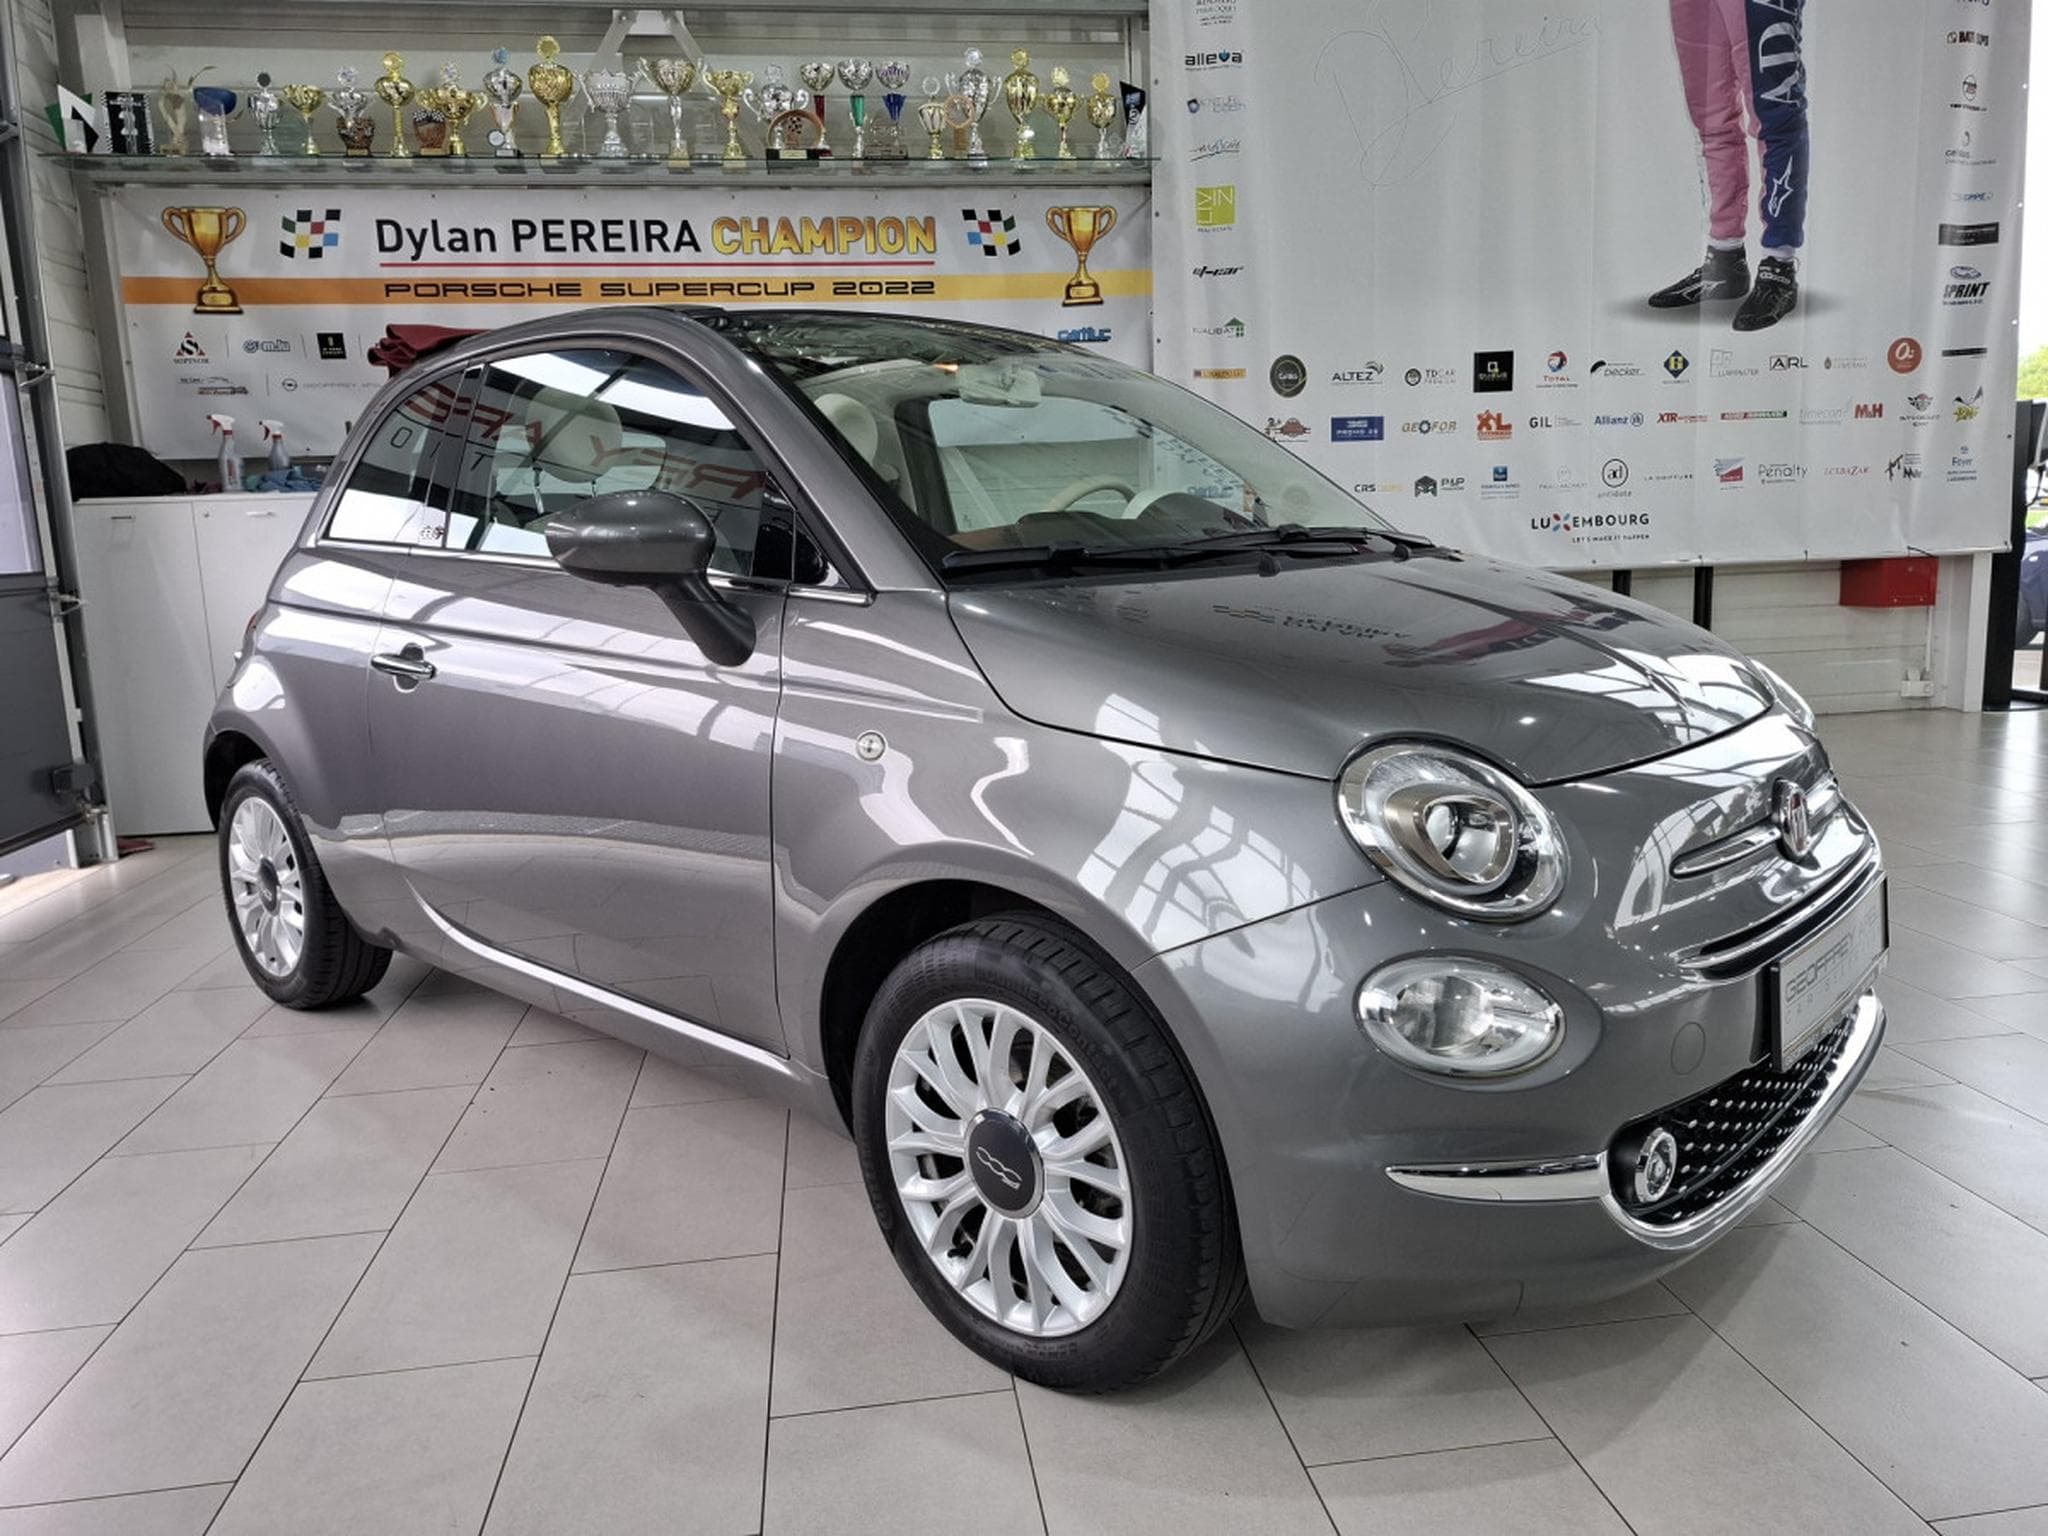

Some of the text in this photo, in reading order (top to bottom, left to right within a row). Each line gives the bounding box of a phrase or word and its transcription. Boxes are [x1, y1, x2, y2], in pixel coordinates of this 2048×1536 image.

[375, 215, 938, 262] Dylan PEREIRA CHAMPION
[384, 280, 935, 298] PORSCHE SUPERCUP 2022
[1770, 356, 1810, 371] ARL
[1332, 371, 1374, 382] ALTEZ
[1529, 416, 1553, 429] GIL
[1594, 415, 1628, 426] Allianz
[1657, 412, 1678, 424] XTR
[1401, 419, 1457, 435] GEOFOR
[1758, 463, 1808, 480] Penalty
[1354, 483, 1377, 493] CRS
[1531, 512, 1651, 532] LUXEMBOURG
